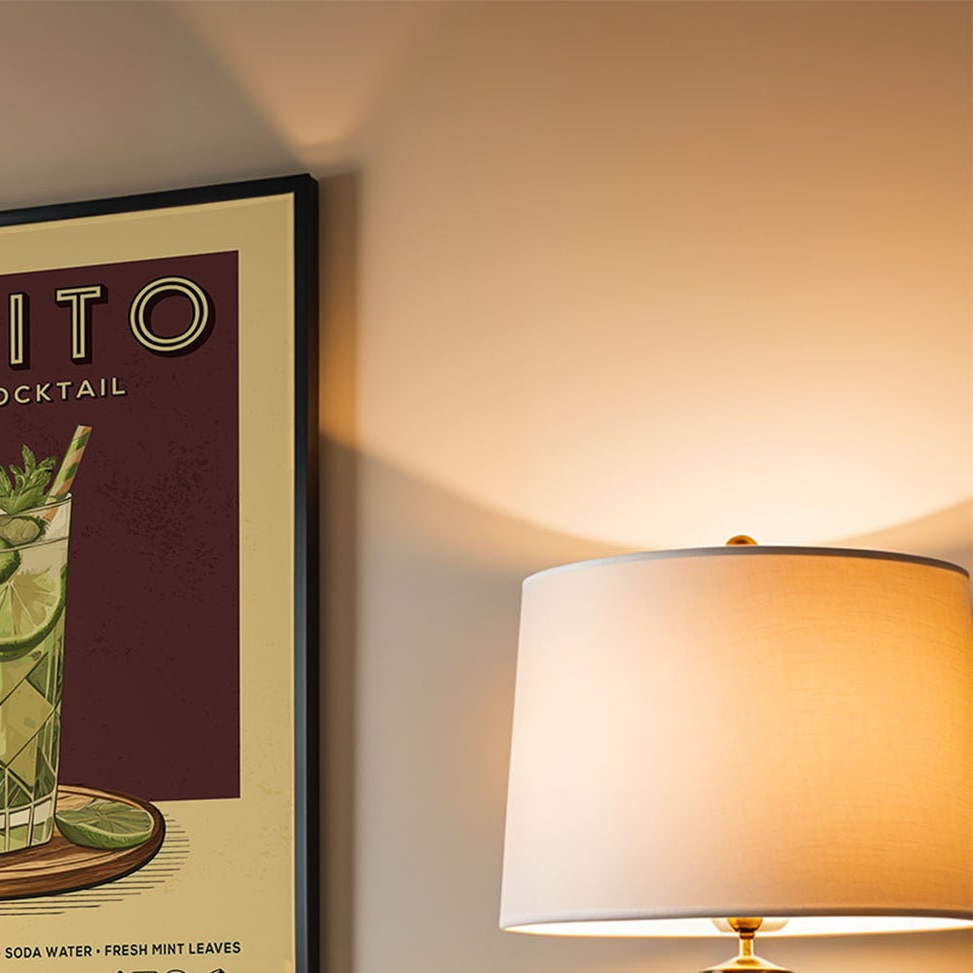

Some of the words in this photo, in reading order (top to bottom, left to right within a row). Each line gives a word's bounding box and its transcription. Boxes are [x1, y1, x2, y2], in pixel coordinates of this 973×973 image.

[4, 946, 42, 960] SODA
[45, 945, 93, 959] WATER
[104, 943, 148, 957] FRESH
[151, 943, 186, 957] MINT
[189, 941, 242, 956] LEAVES
